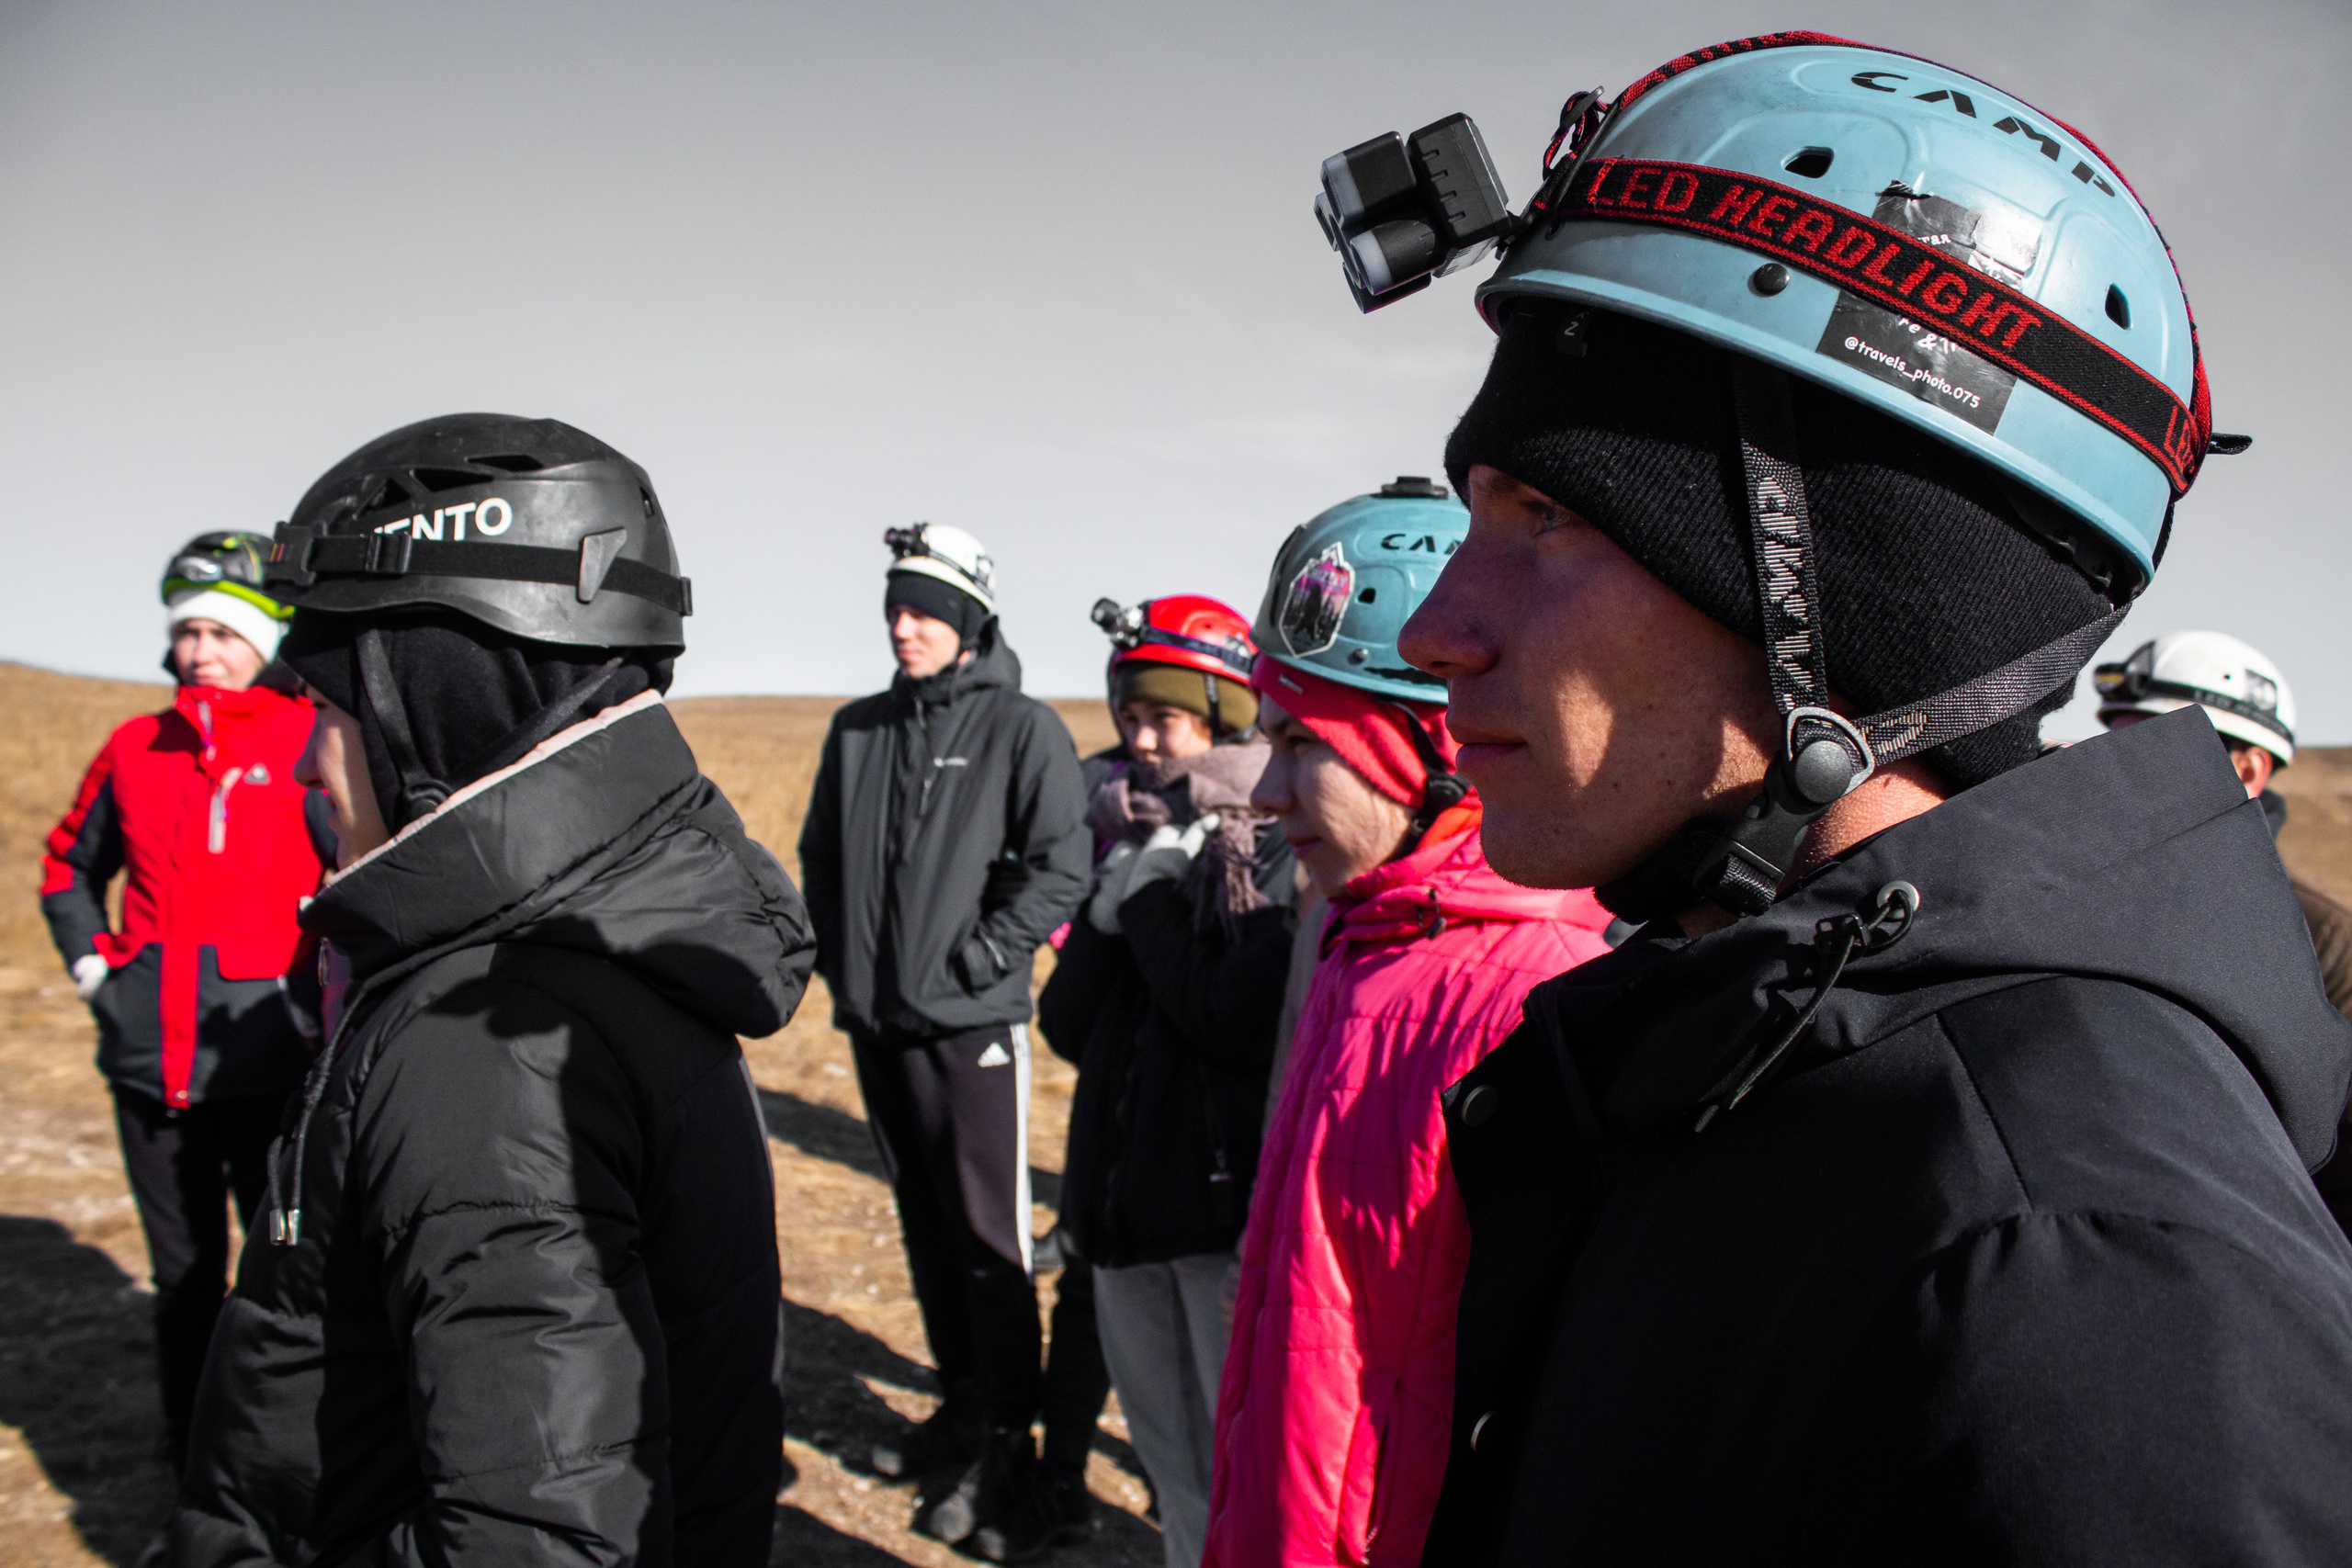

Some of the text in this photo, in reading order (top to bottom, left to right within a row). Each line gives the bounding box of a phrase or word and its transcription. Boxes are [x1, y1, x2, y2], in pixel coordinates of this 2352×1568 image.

[1850, 71, 2116, 197] CAMP
[1587, 158, 2043, 350] LED HEADLIGHT
[1844, 336, 1982, 409] @travels_photo.075
[373, 497, 514, 541] NTO
[1756, 475, 1816, 710] AMP
